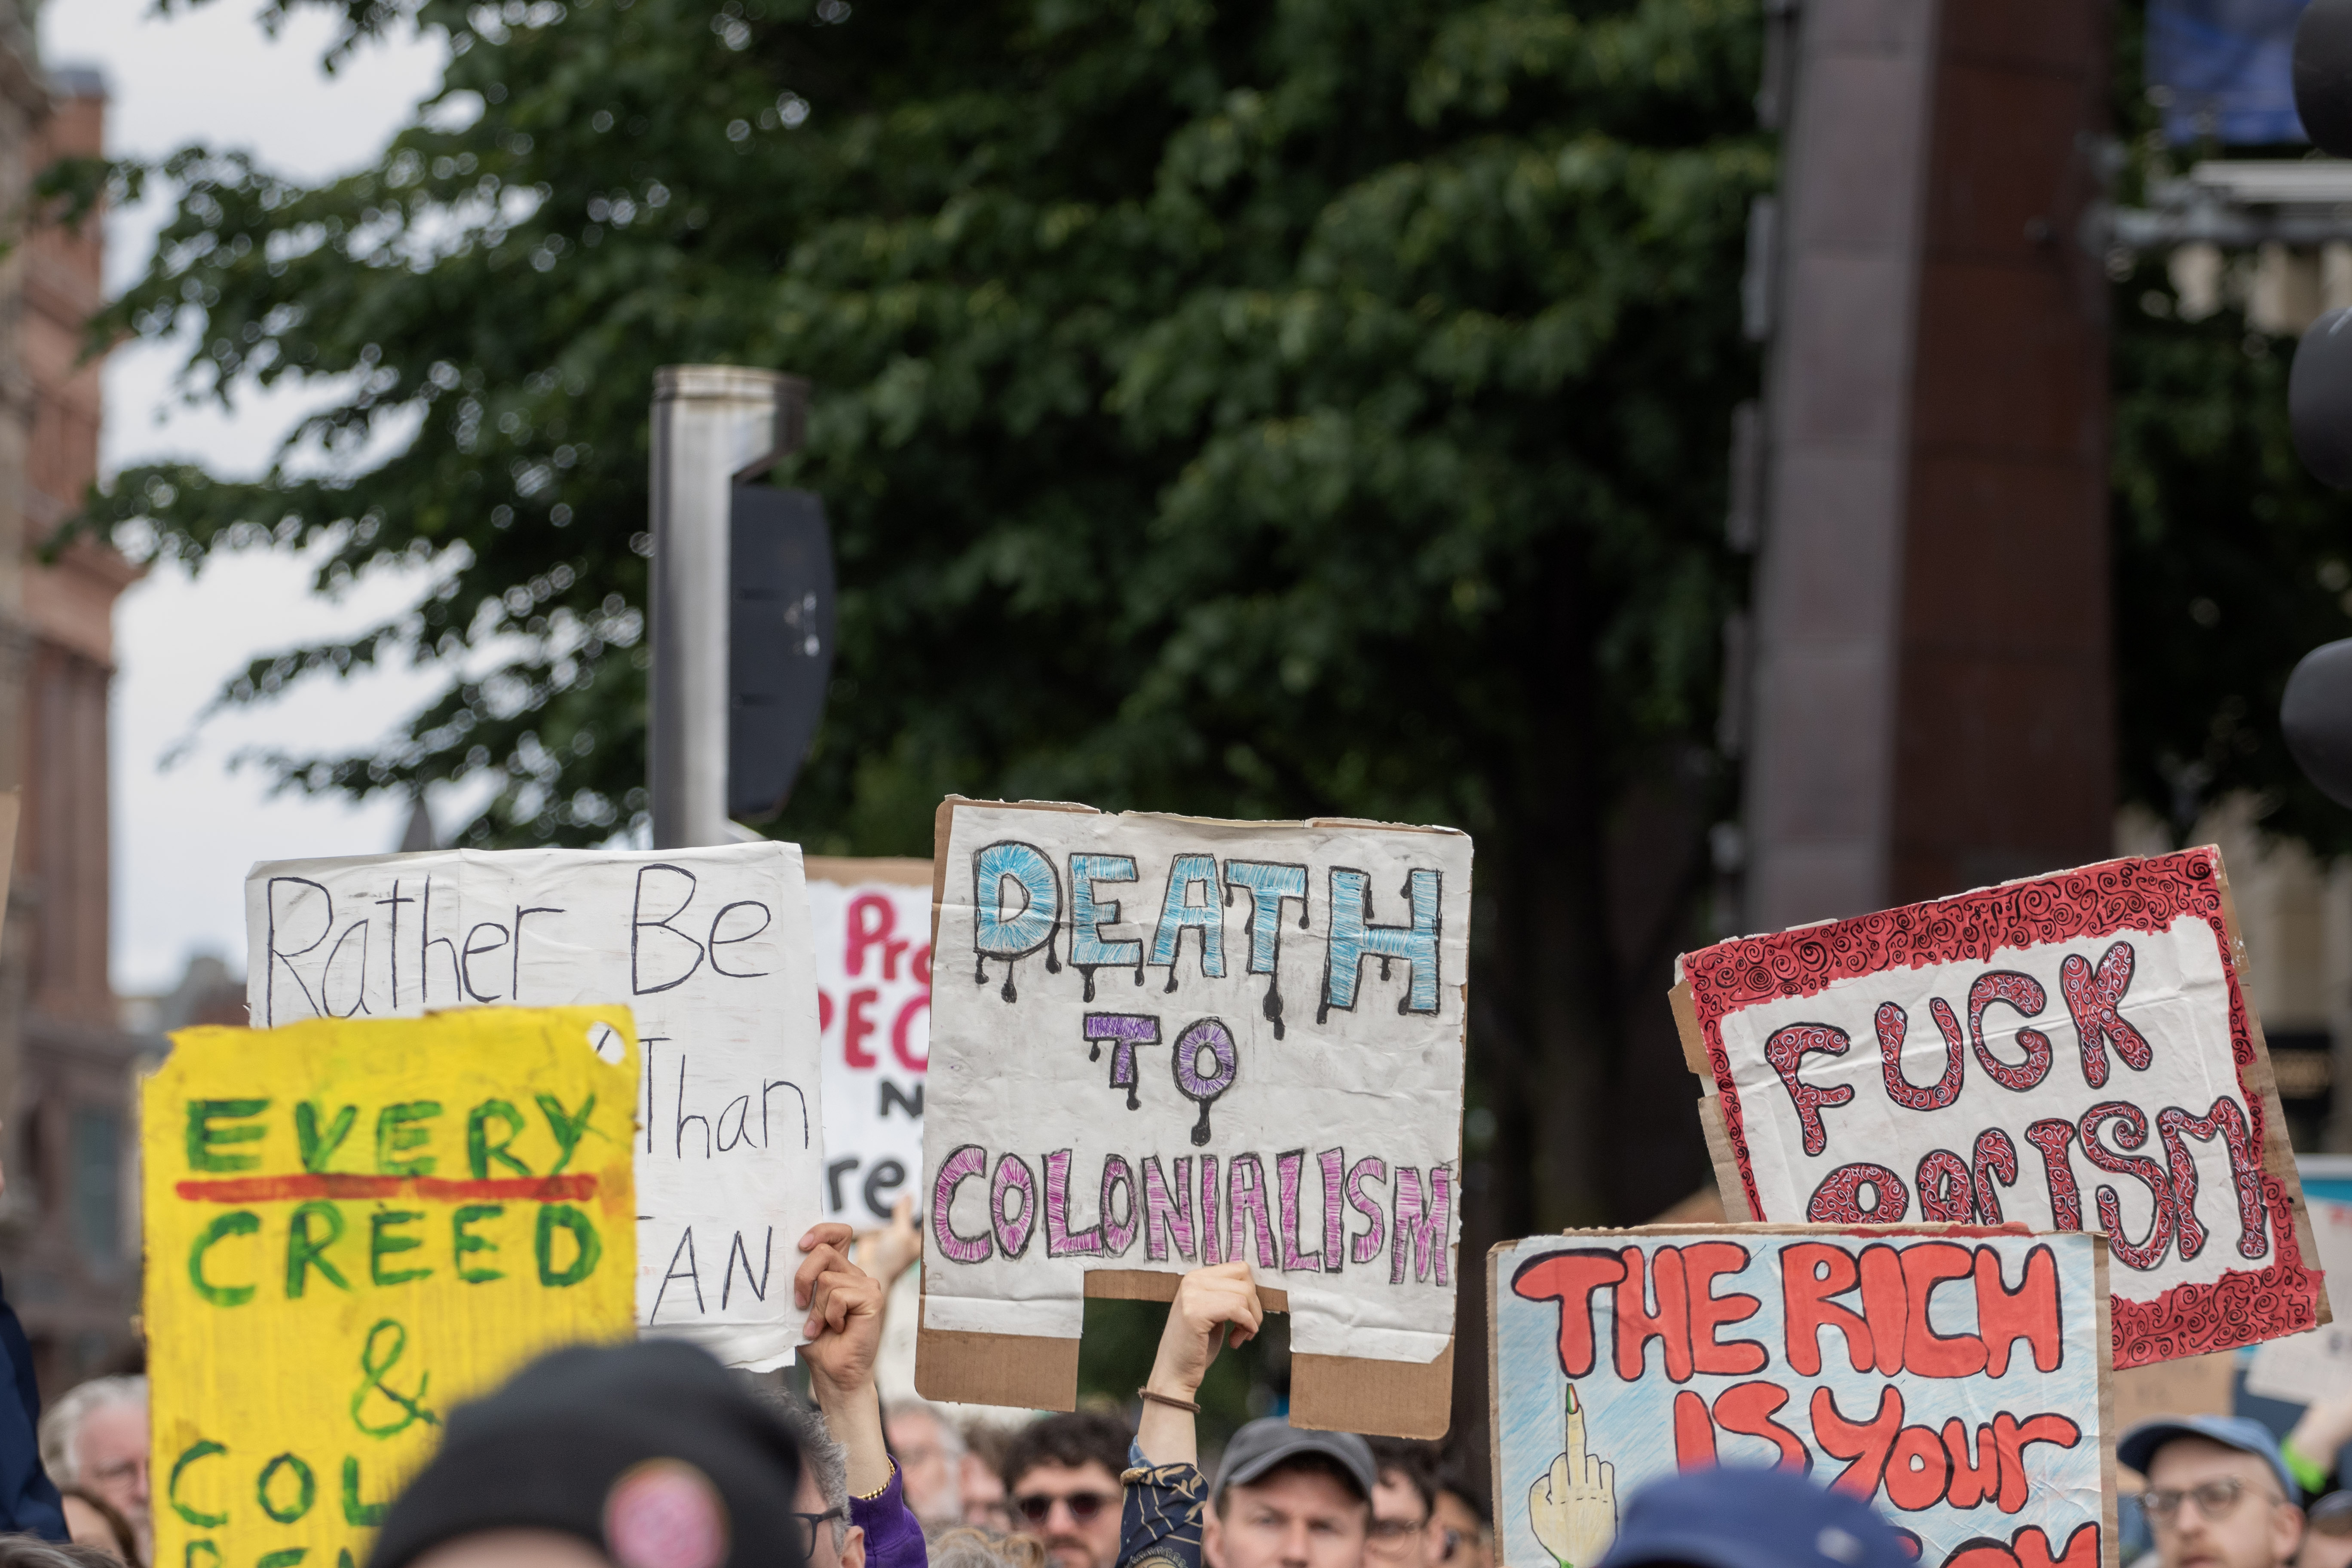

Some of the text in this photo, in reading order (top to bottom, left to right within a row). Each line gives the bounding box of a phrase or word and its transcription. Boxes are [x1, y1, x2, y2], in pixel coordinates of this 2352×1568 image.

[266, 864, 772, 1030] Rather Be
[972, 839, 1443, 1018] DEATH
[636, 1037, 809, 1160] Than
[1083, 1013, 1238, 1113] TO
[1764, 941, 2153, 1156] FUCK
[184, 1093, 597, 1180] EVERY
[188, 1200, 601, 1308] CREED
[636, 1215, 773, 1326] AN
[932, 1143, 1452, 1287] COLONIALISM
[1511, 1240, 2063, 1384] THE RICH
[350, 1318, 442, 1441] &
[1673, 1380, 1813, 1479] IS
